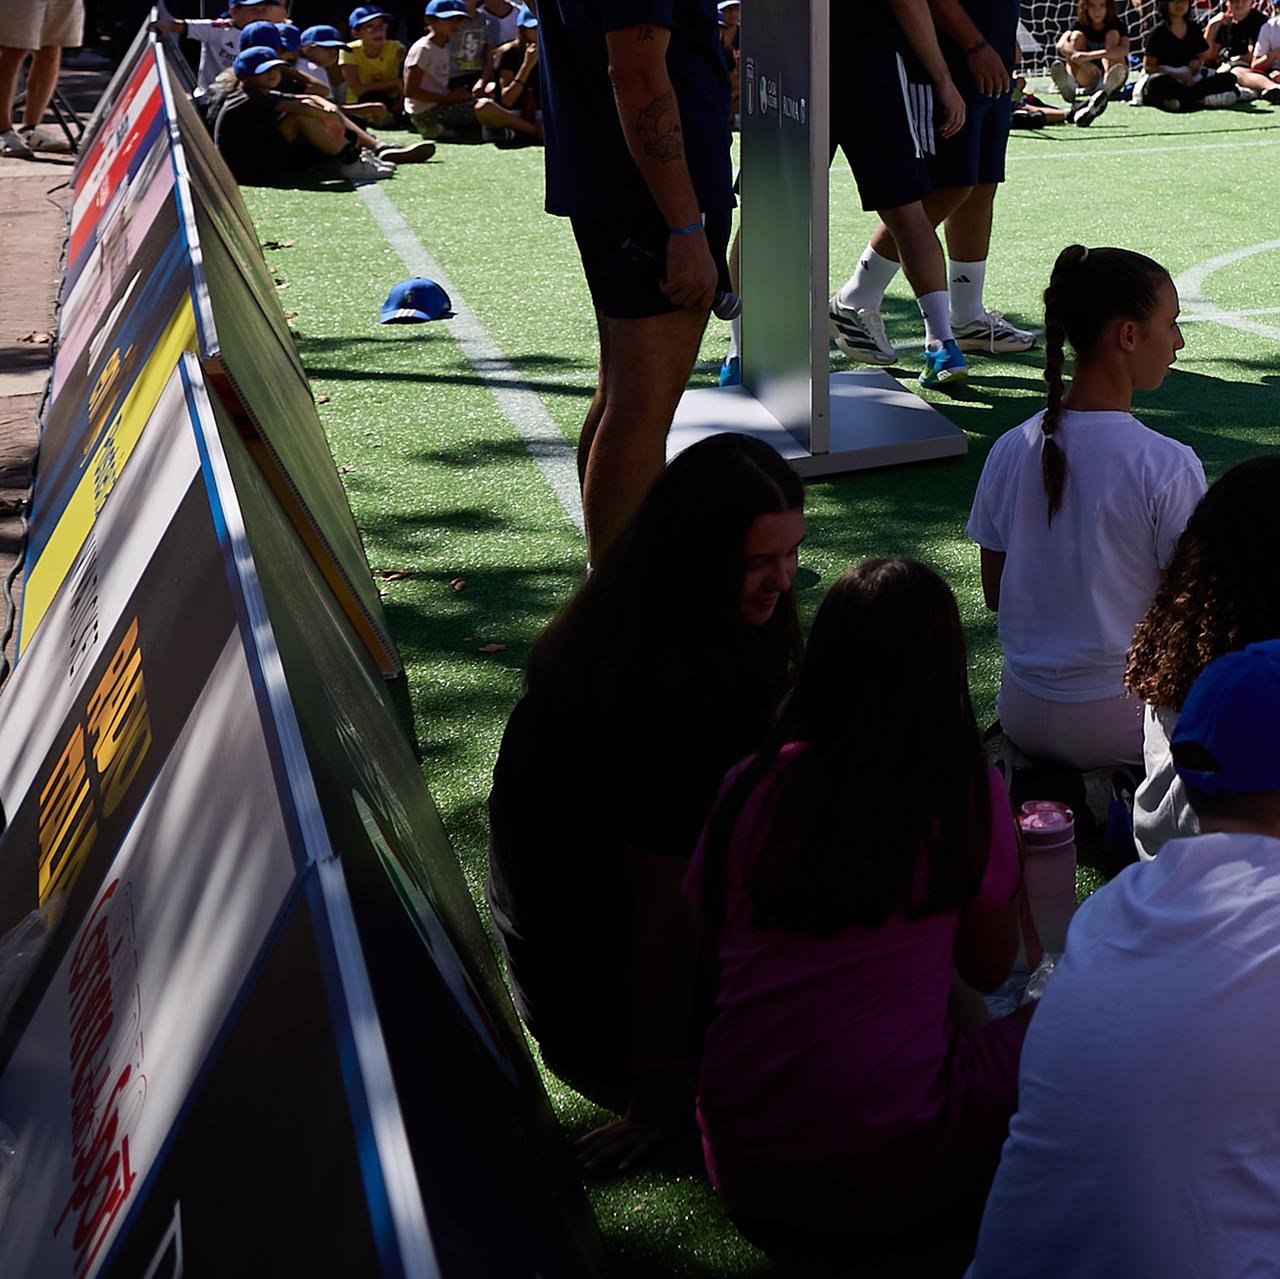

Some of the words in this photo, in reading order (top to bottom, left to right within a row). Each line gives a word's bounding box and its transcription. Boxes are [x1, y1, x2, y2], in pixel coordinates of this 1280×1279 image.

[70, 532, 99, 688] VIVATICKET
[86, 616, 153, 818] RADIO
[37, 722, 97, 915] ITALIA
[69, 878, 124, 1100] Corriere
[53, 1063, 138, 1279] Sport
